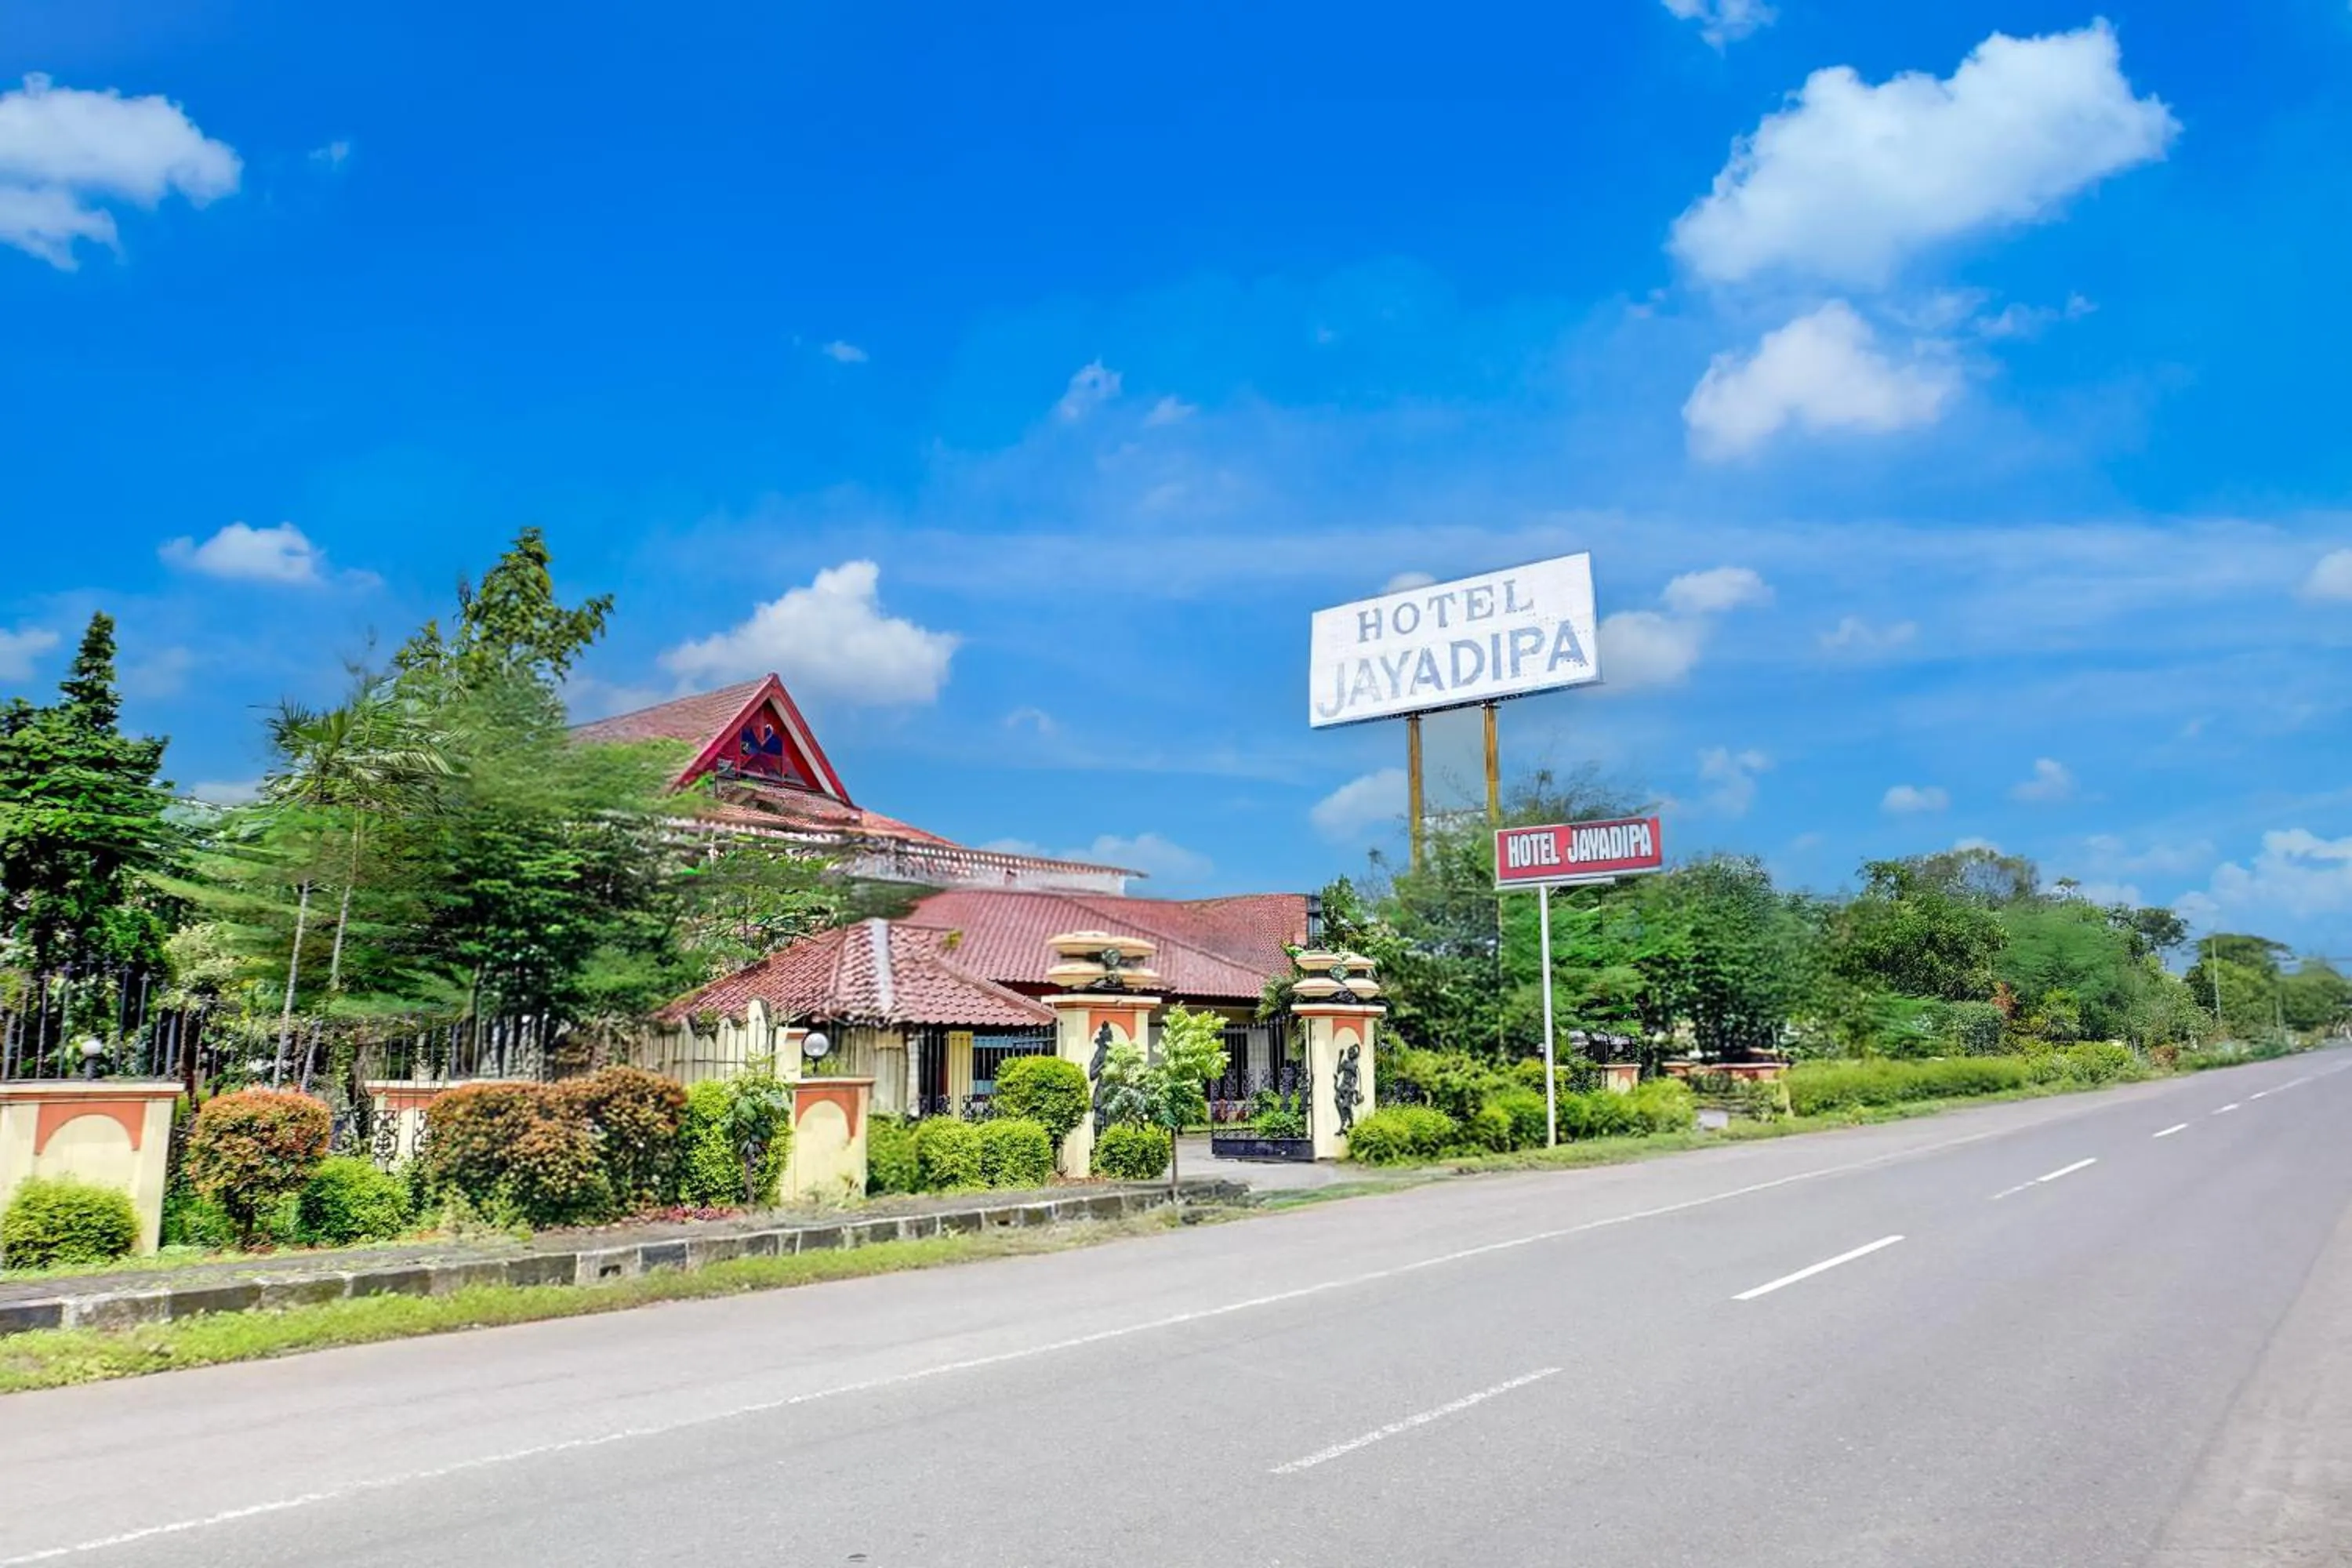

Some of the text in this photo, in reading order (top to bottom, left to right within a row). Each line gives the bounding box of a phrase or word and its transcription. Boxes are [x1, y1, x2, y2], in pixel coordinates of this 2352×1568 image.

[1357, 579, 1534, 643] HOTEL
[1316, 619, 1588, 718] JAYADIPA
[1508, 823, 1652, 868] HOTEL JAYADIPA
